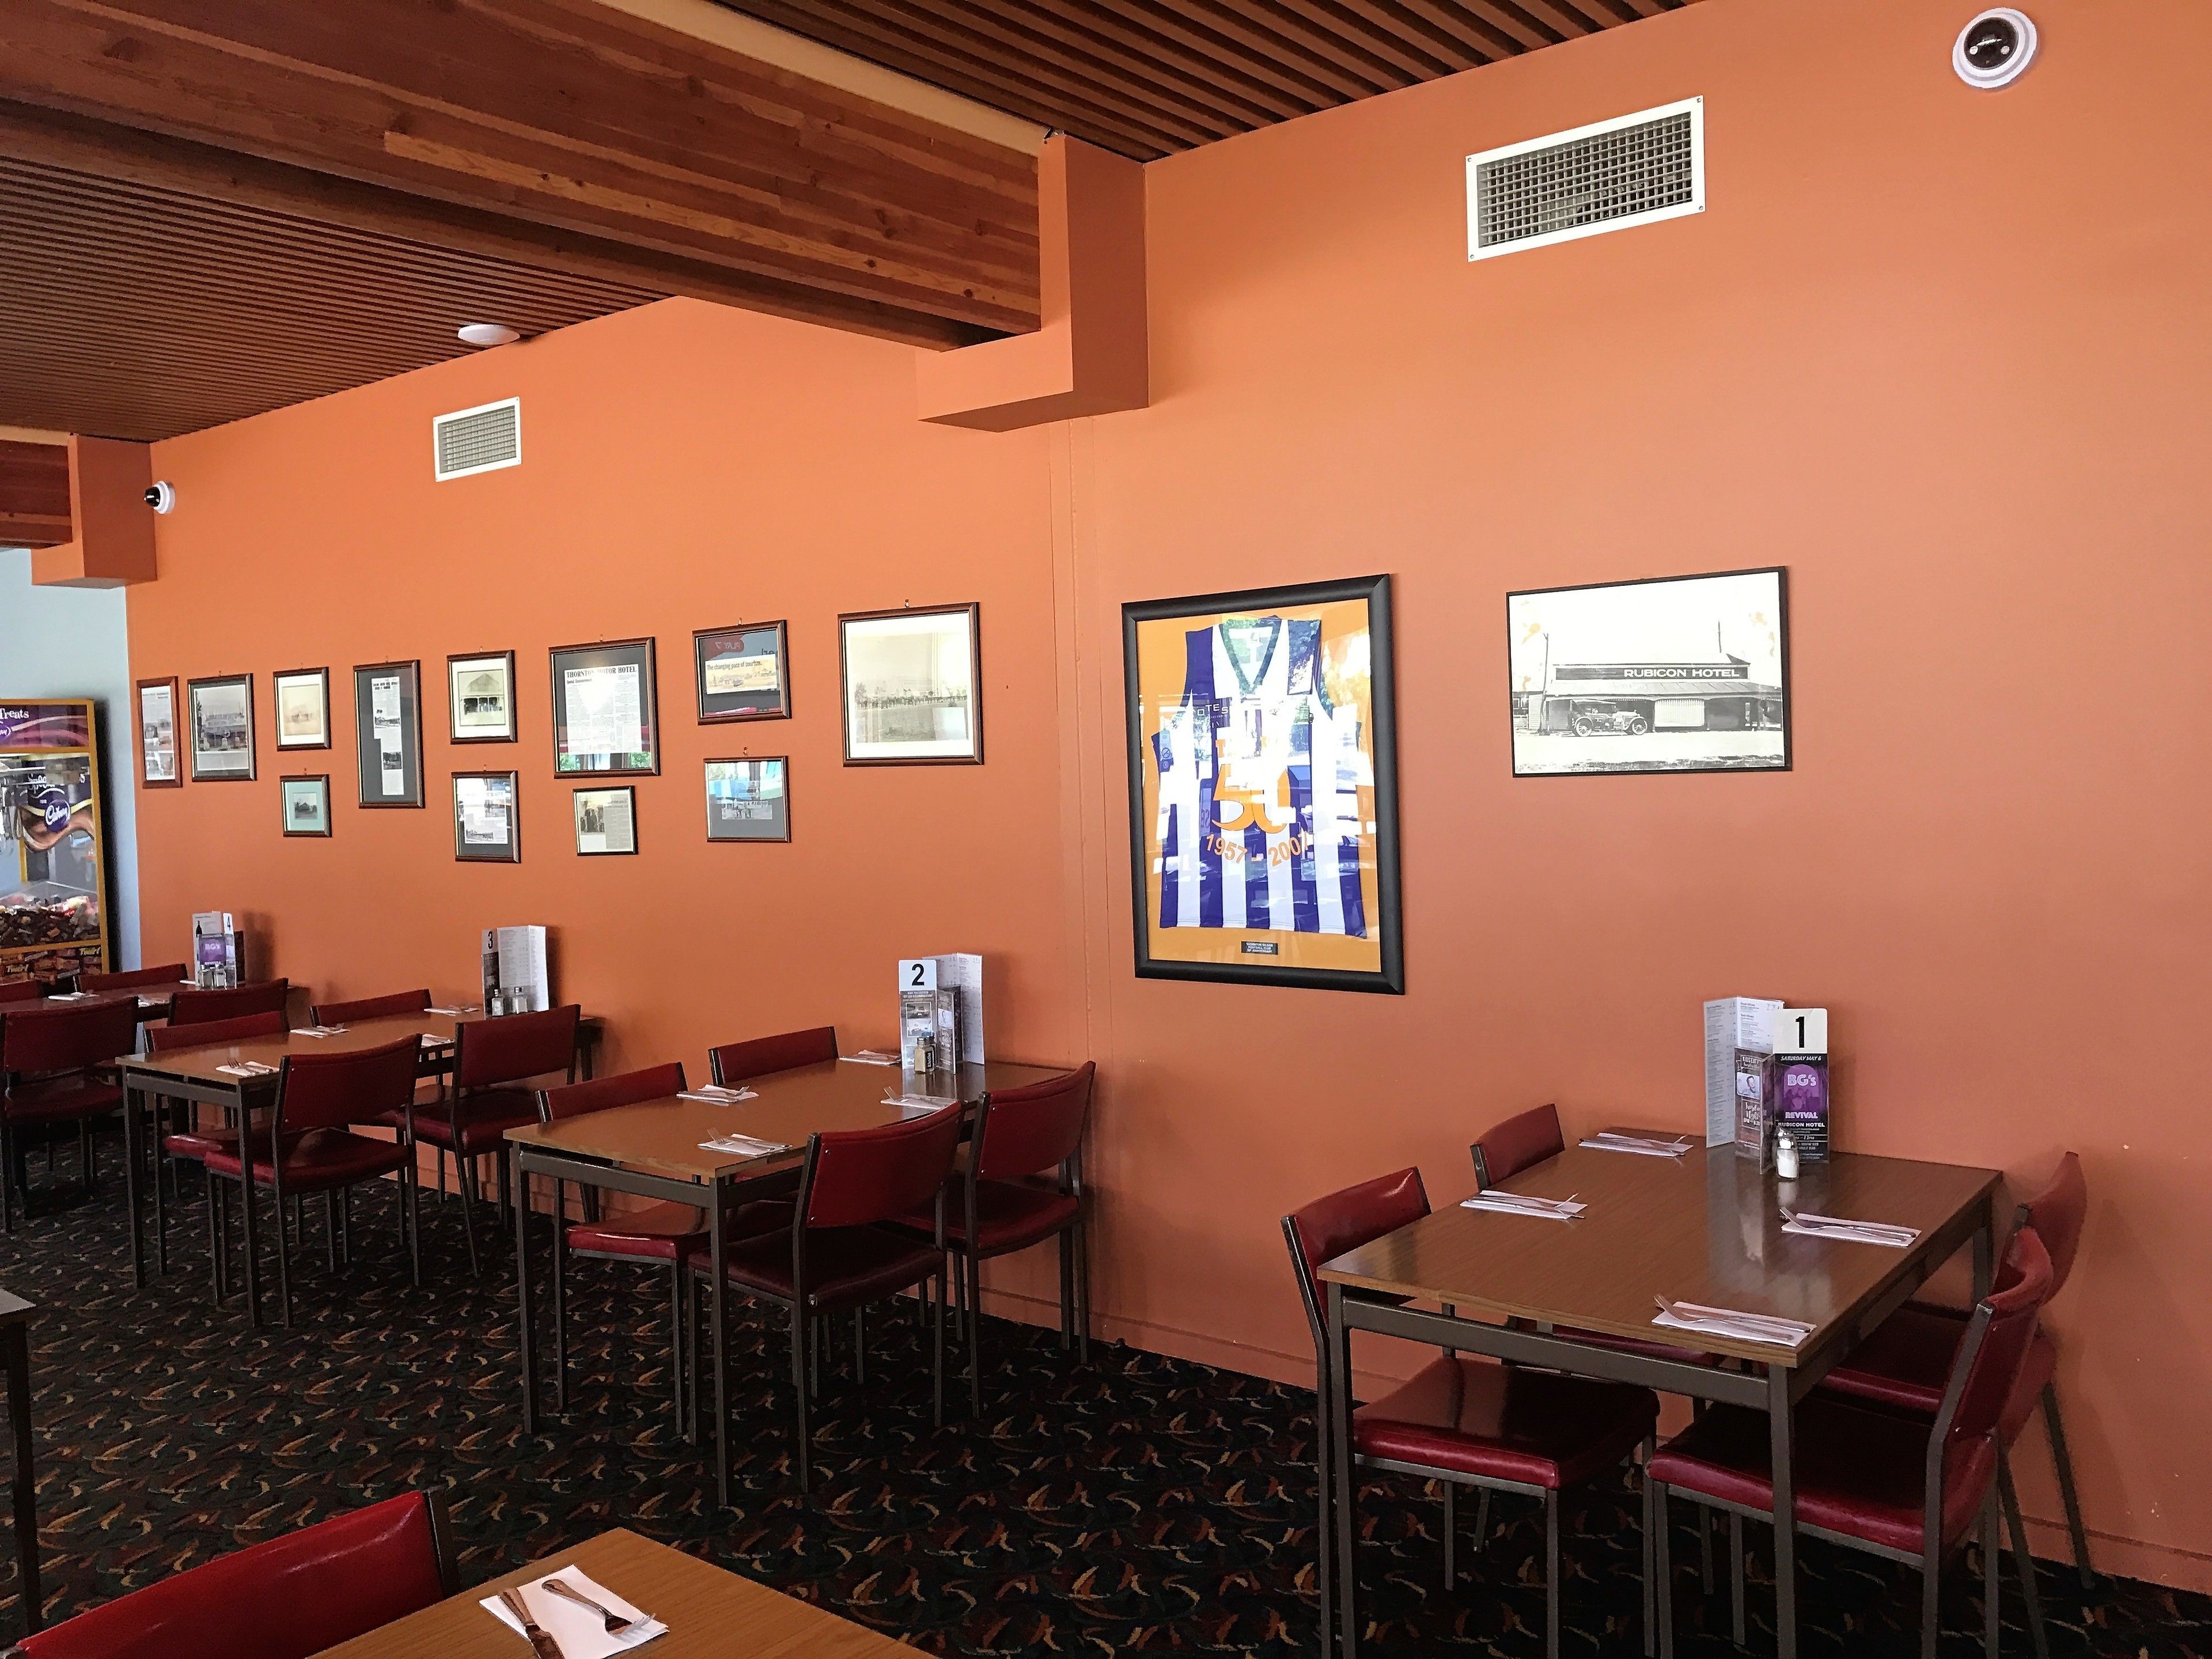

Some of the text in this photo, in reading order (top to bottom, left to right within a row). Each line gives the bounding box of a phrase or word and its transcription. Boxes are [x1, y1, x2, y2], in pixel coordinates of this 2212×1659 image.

[1624, 668, 1740, 678] RUBICON HOTEL
[1206, 834, 1248, 864] 1957
[487, 931, 493, 949] 3
[911, 963, 925, 986] 2
[1795, 1016, 1805, 1048] 1
[1787, 1074, 1817, 1086] BG's
